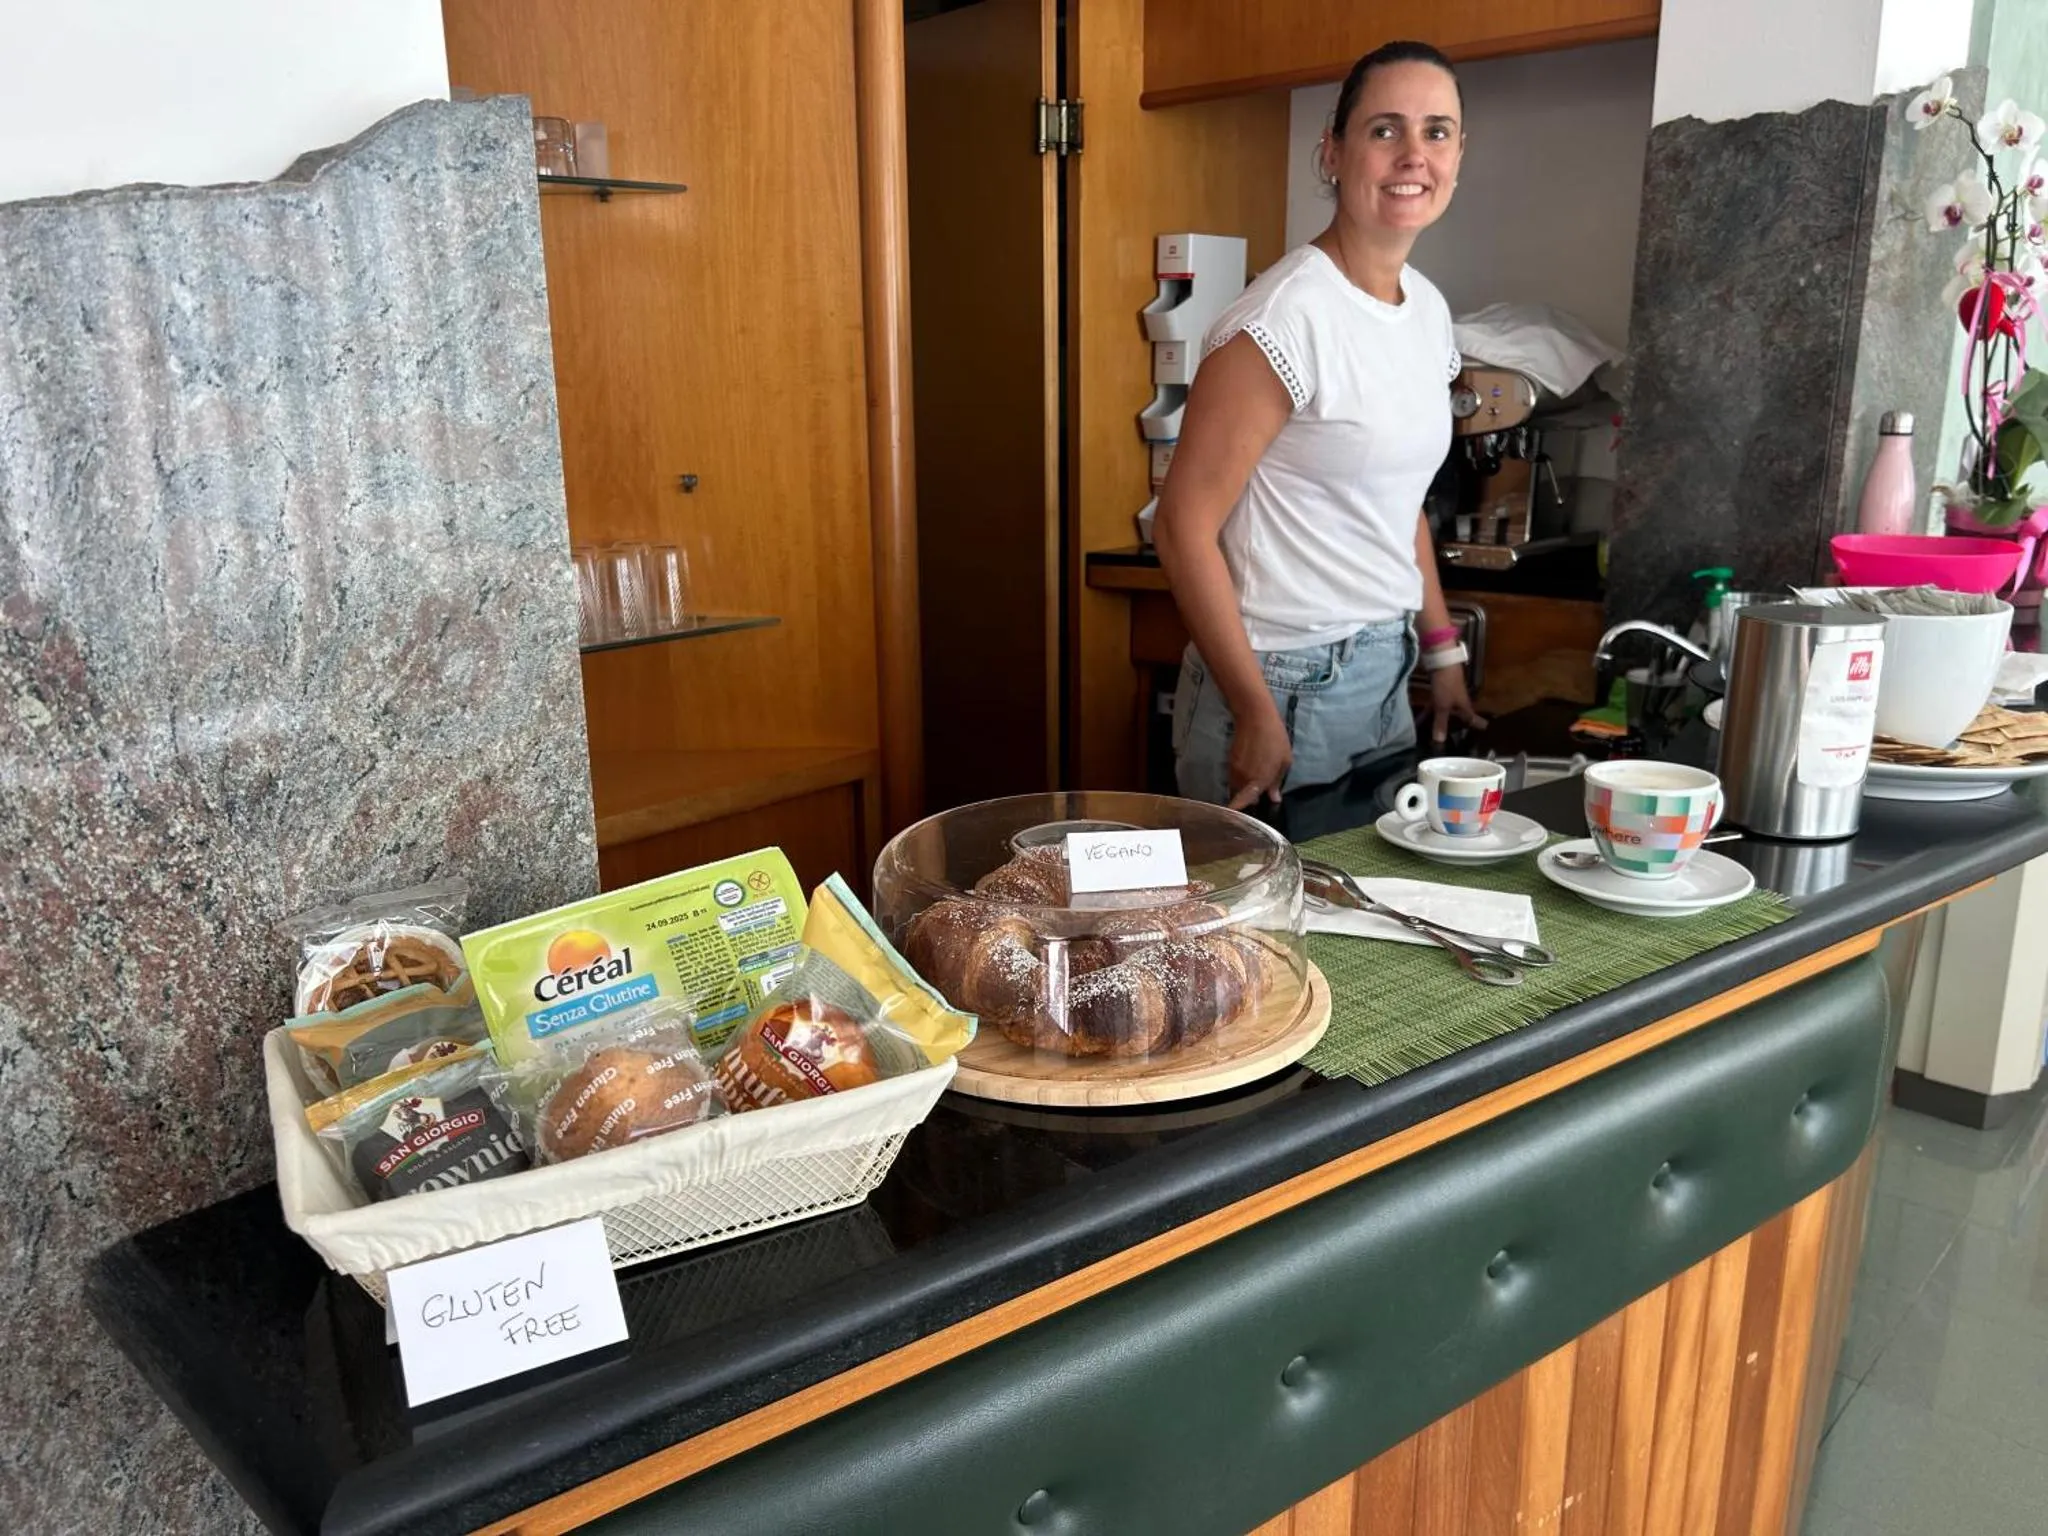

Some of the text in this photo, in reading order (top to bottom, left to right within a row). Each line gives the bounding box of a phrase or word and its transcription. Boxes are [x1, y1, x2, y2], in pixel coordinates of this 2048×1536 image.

[1849, 656, 1872, 678] illy
[1085, 843, 1152, 861] VEGANO
[645, 912, 689, 931] 24.09.2025
[534, 947, 633, 1002] Céréal
[535, 1005, 588, 1033] Senza
[589, 982, 651, 1013] Glutine
[763, 1027, 785, 1052] SAN
[646, 1056, 675, 1075] Free
[724, 1047, 794, 1107] muf
[575, 1066, 618, 1109] Gluten
[663, 1087, 695, 1110] Free
[556, 1107, 579, 1140] Free
[600, 1098, 636, 1136] Gluten
[379, 1145, 412, 1173] SAN
[413, 1112, 479, 1147] GIORGIO
[407, 1130, 526, 1197] ownie
[422, 1261, 545, 1328] GLUTEN
[500, 1304, 582, 1345] FREE
